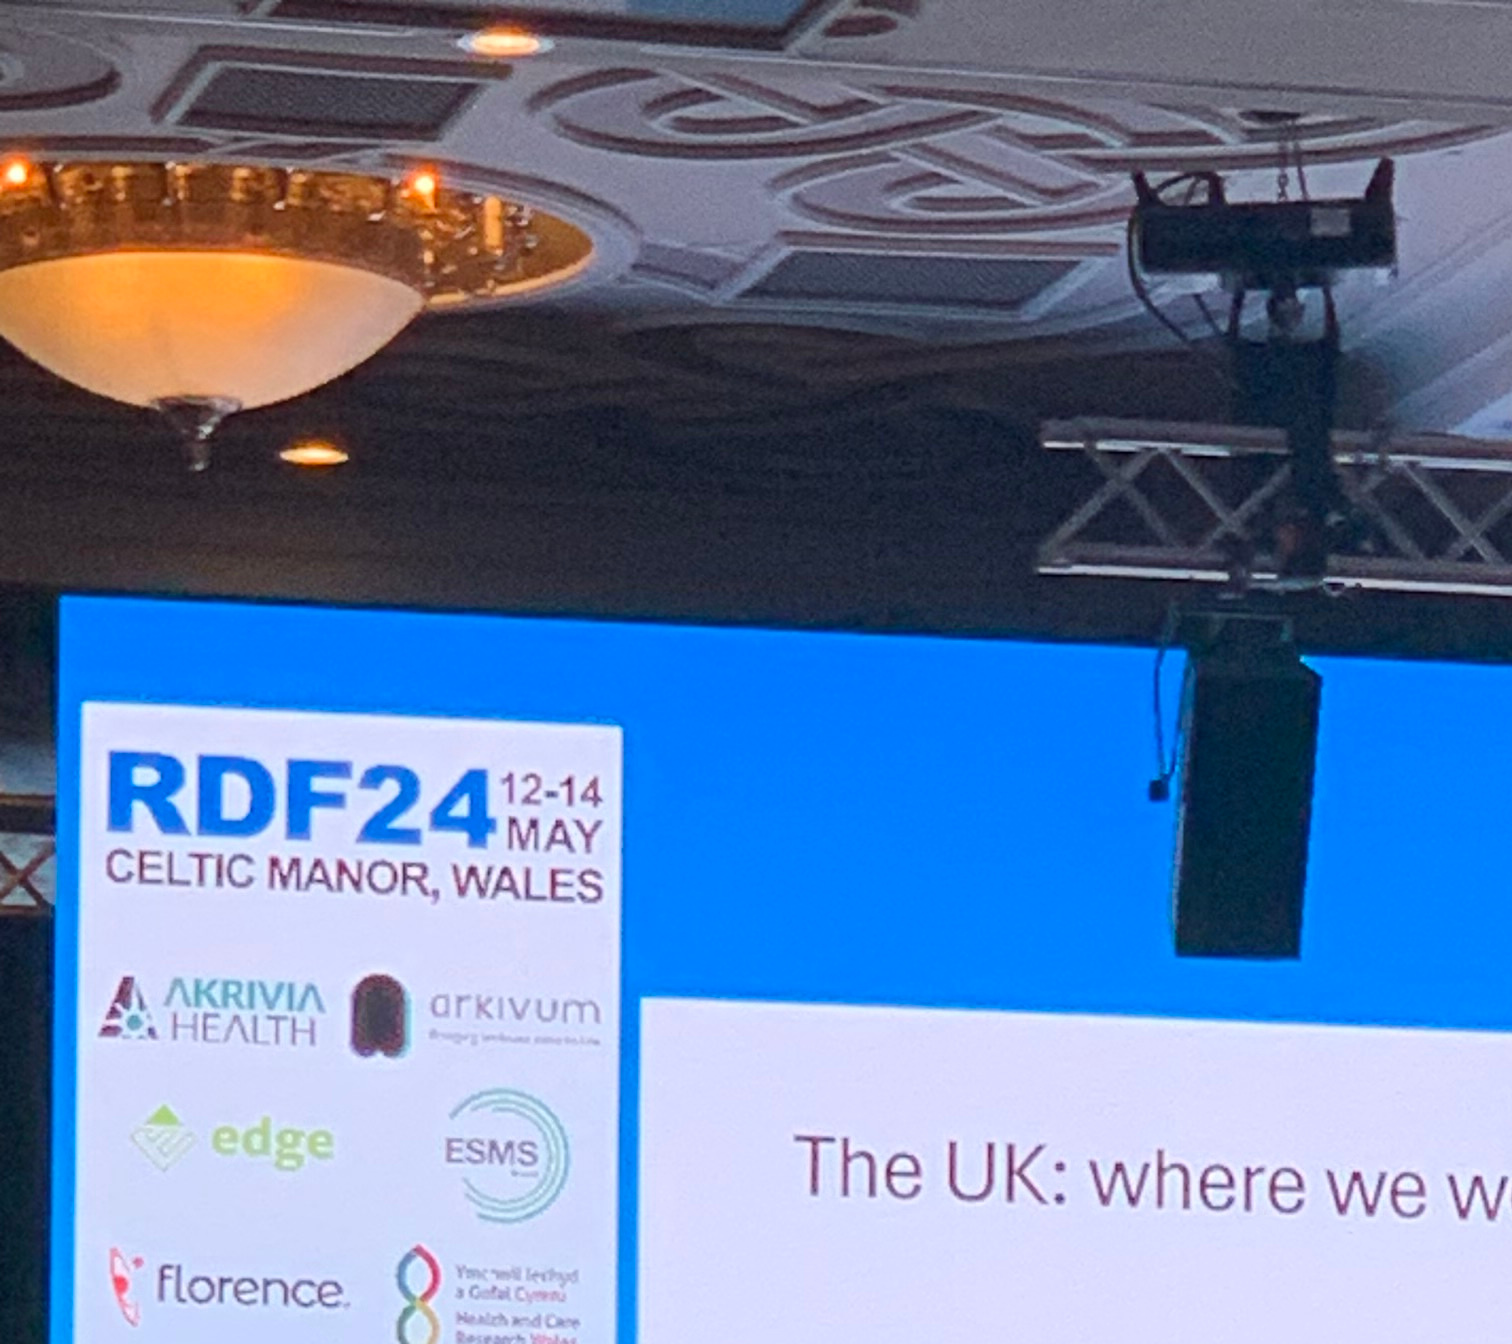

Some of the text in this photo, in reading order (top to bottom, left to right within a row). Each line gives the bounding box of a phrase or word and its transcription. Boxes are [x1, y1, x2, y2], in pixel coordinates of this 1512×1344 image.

[108, 751, 602, 848] RDF24 12-14
[508, 816, 602, 853] MAY
[107, 849, 602, 904] CELTIC MANOR, WALES
[164, 978, 324, 1012] AKRIVIA
[430, 994, 600, 1024] arkivum
[172, 1013, 317, 1045] HEALTH
[213, 1118, 333, 1171] edge
[446, 1138, 538, 1166] ESMS
[795, 1136, 921, 1199] The
[949, 1142, 1065, 1204] UK:
[1089, 1149, 1304, 1213] where
[1327, 1170, 1425, 1218] we
